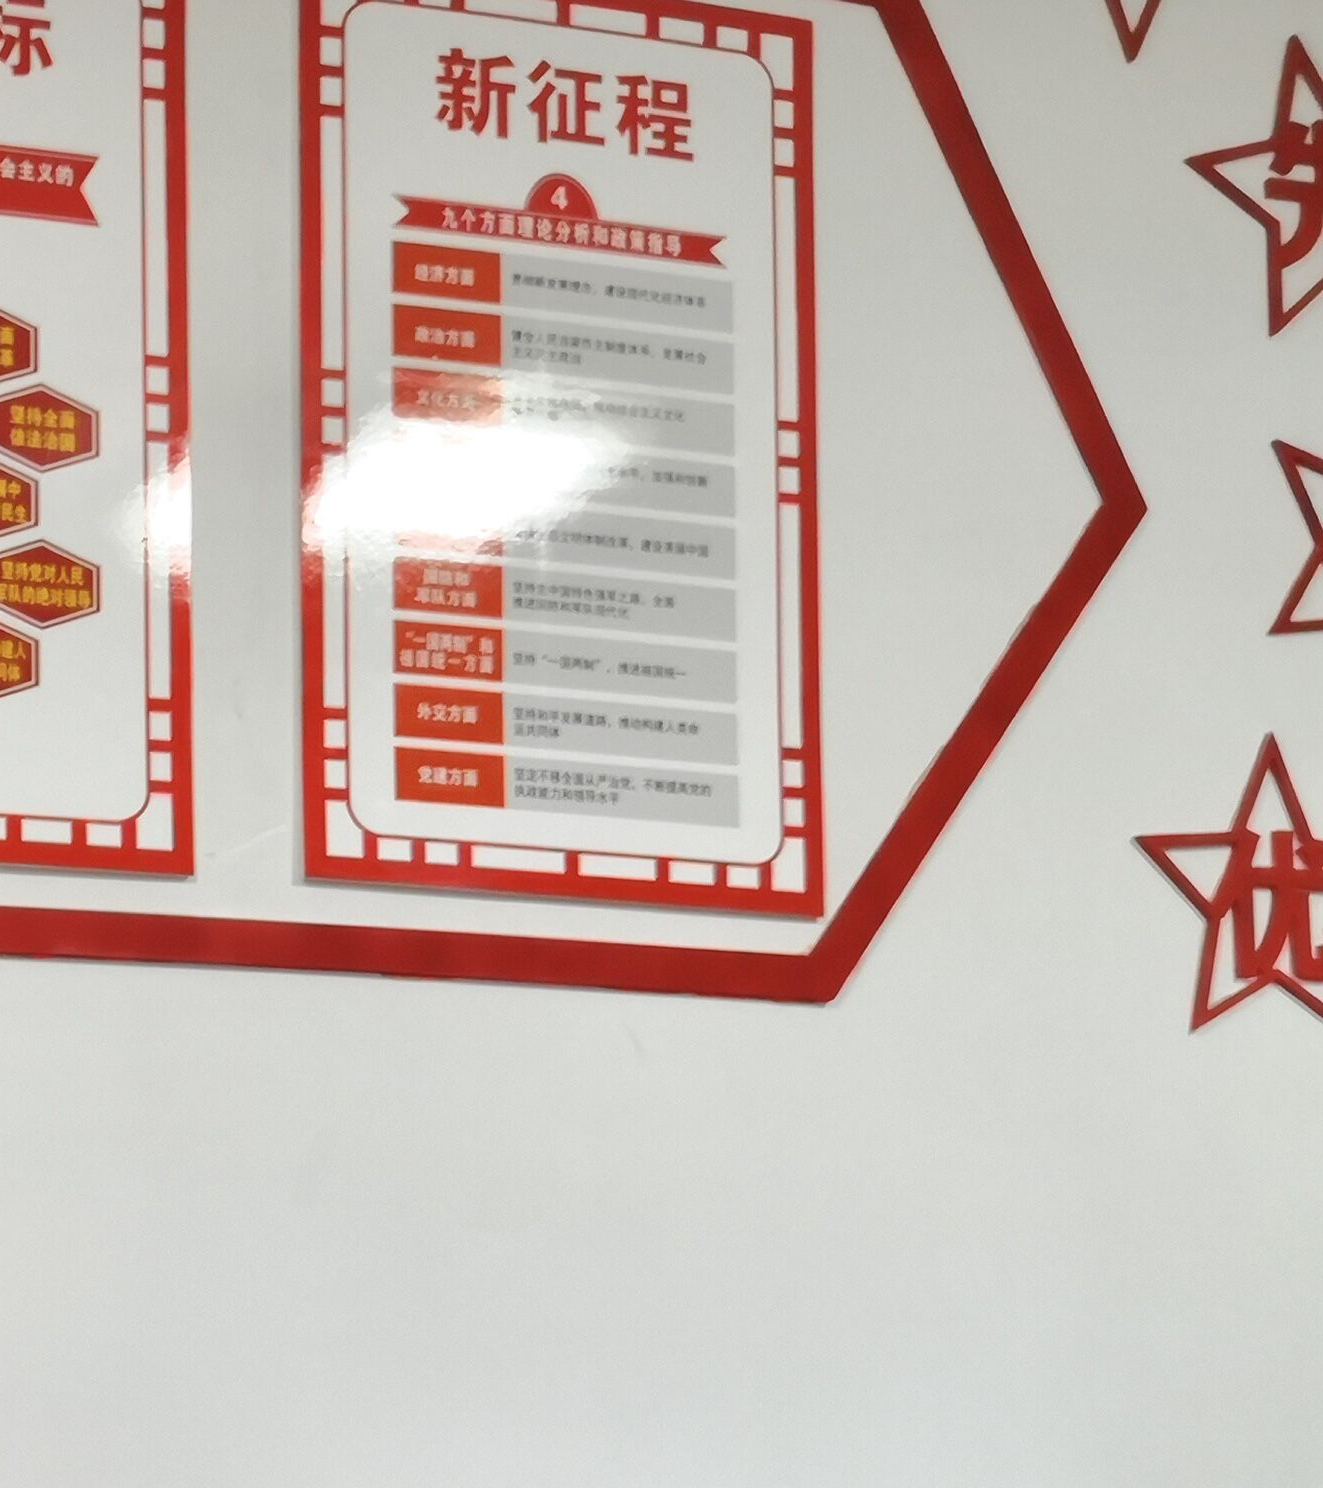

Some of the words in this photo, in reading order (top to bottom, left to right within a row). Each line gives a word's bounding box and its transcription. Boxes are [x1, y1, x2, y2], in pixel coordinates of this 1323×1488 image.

[435, 48, 695, 162] 新征程
[550, 186, 567, 210] 4
[415, 264, 475, 287] 经济方面
[414, 325, 475, 348] 政治方面
[9, 405, 76, 430] 坚持全面
[1, 562, 84, 586] 坚持党对人民
[414, 586, 477, 608] 军队方面
[416, 702, 478, 724] 外交方面
[417, 765, 478, 788] 党建方面
